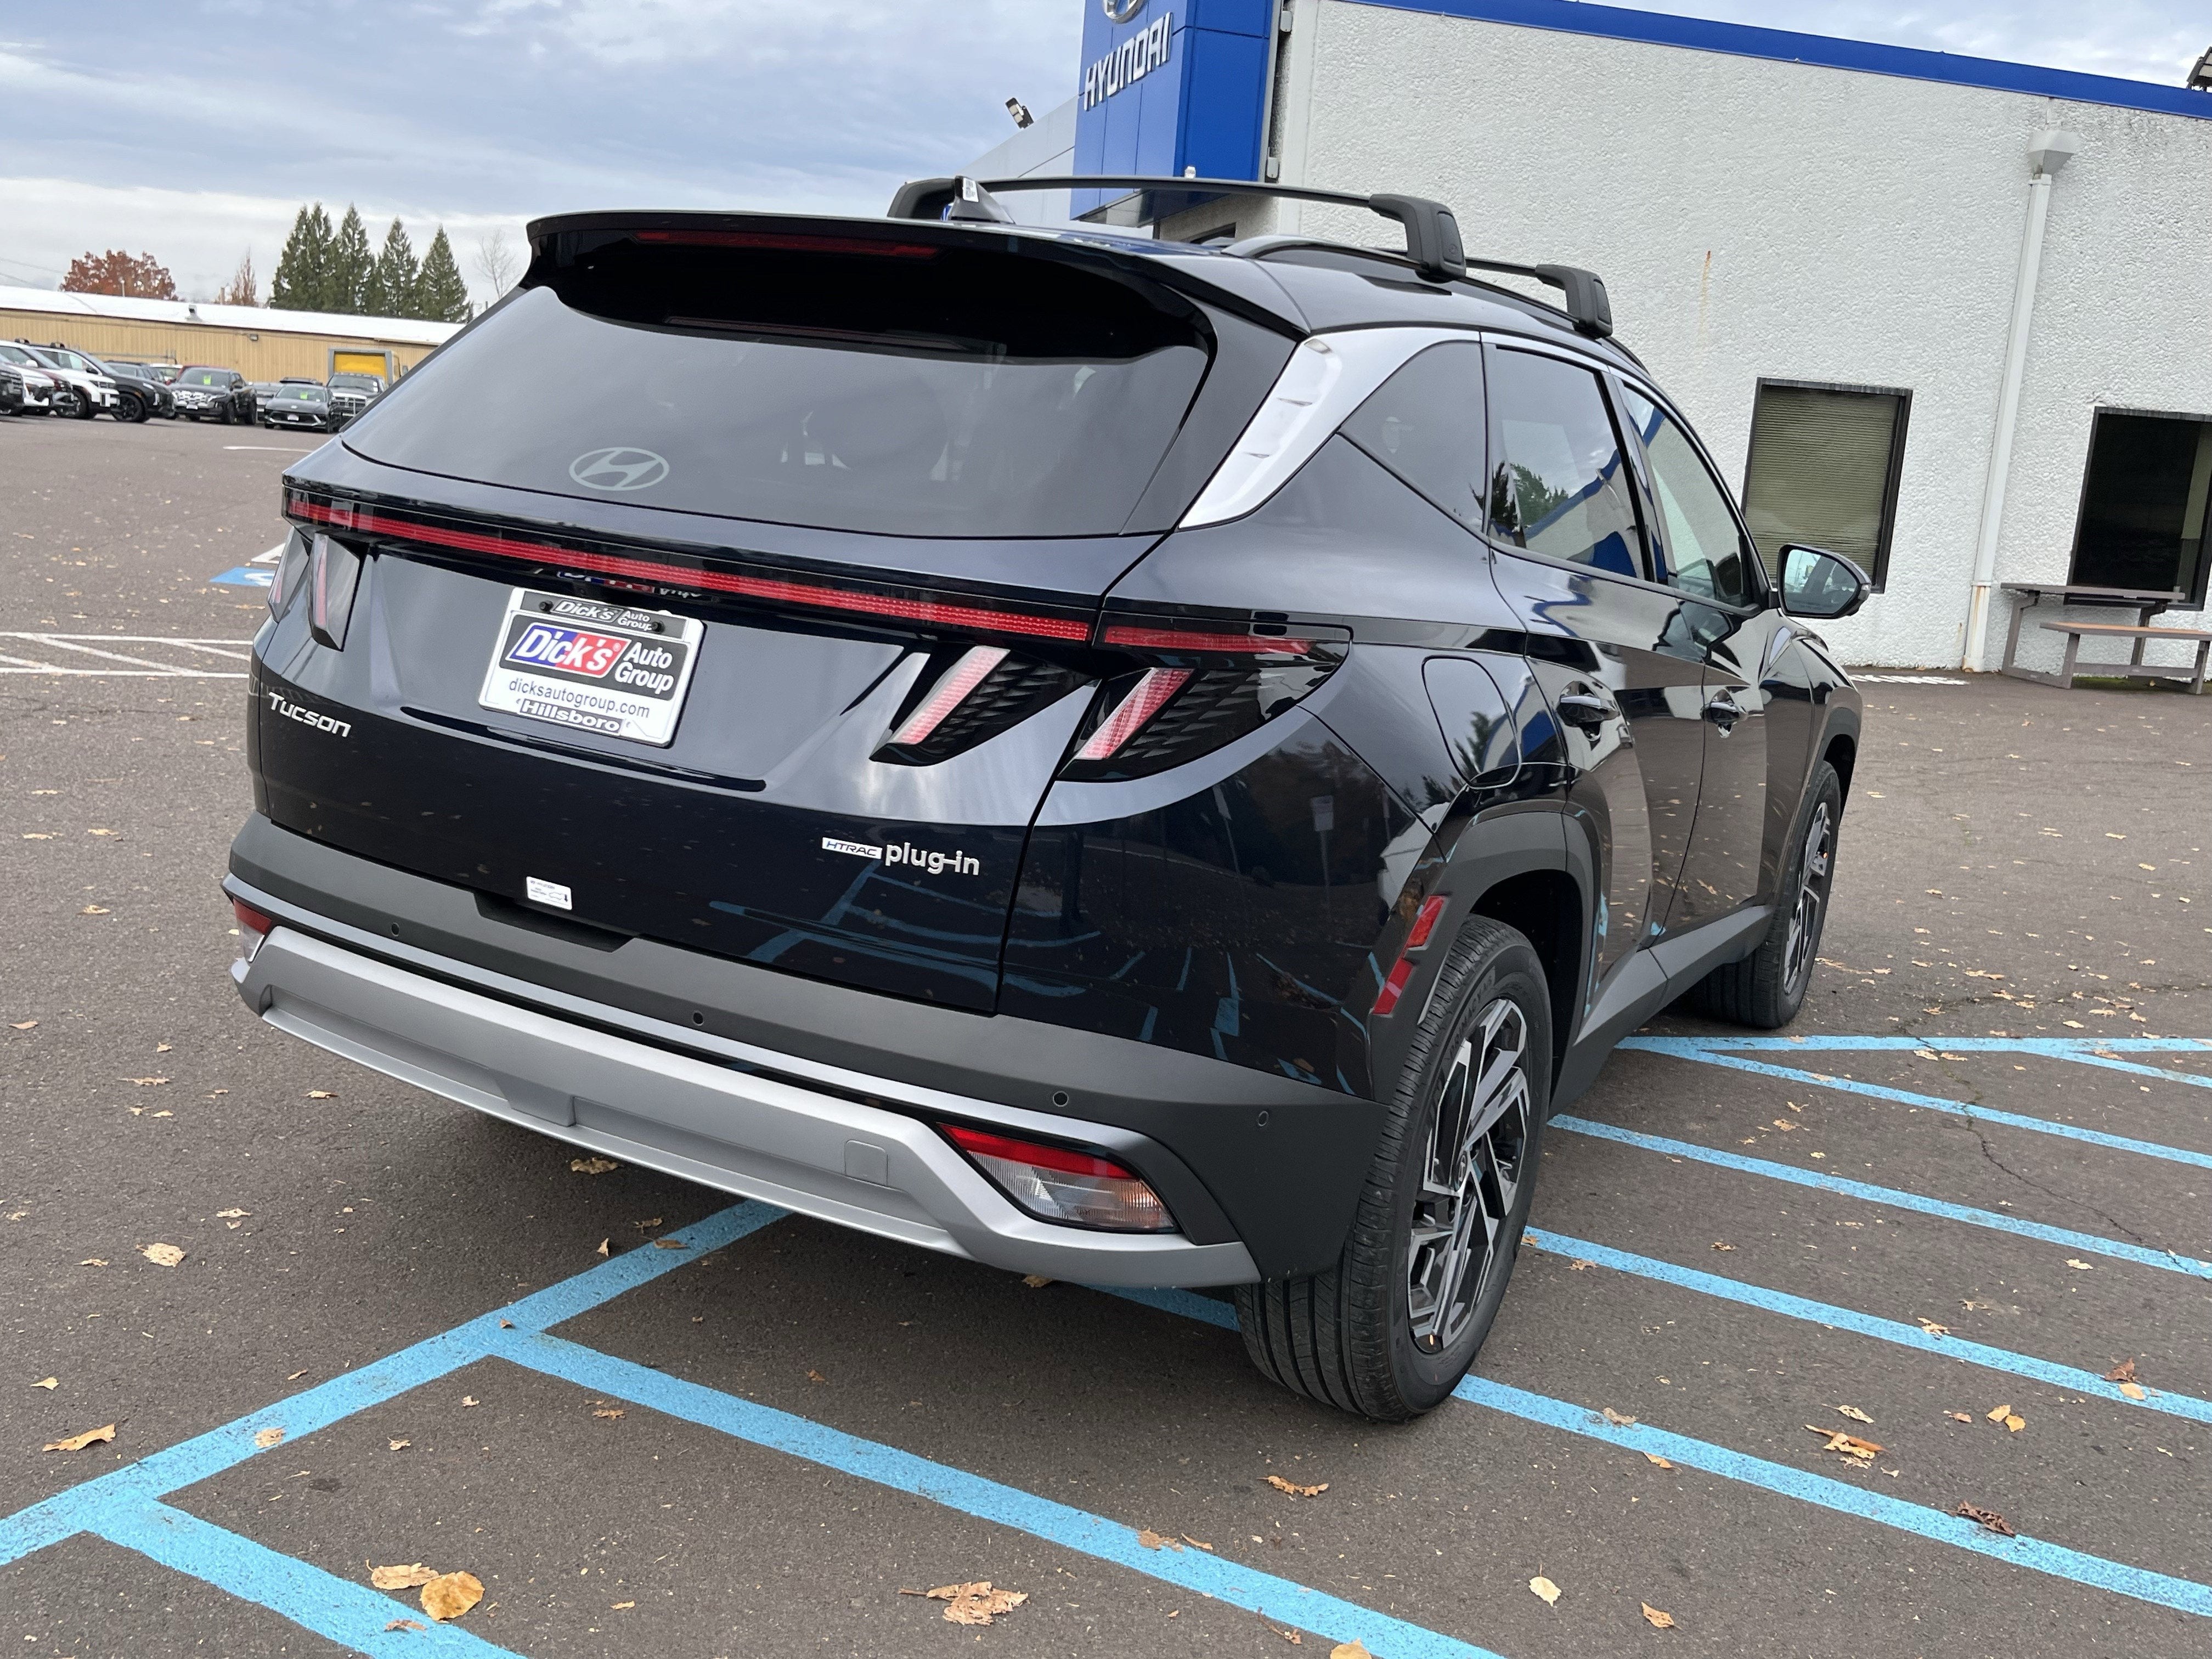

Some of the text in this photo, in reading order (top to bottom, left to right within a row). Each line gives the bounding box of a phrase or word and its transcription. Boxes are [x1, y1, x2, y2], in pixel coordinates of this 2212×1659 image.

[1084, 12, 1173, 111] HYUNDAI
[623, 610, 651, 622] Auto
[623, 642, 673, 669] Auto
[614, 662, 675, 695] Group
[509, 678, 651, 718] dicksautogroup.com
[522, 700, 620, 731] Hillsboro
[826, 840, 980, 876] HTRAC plug-in
